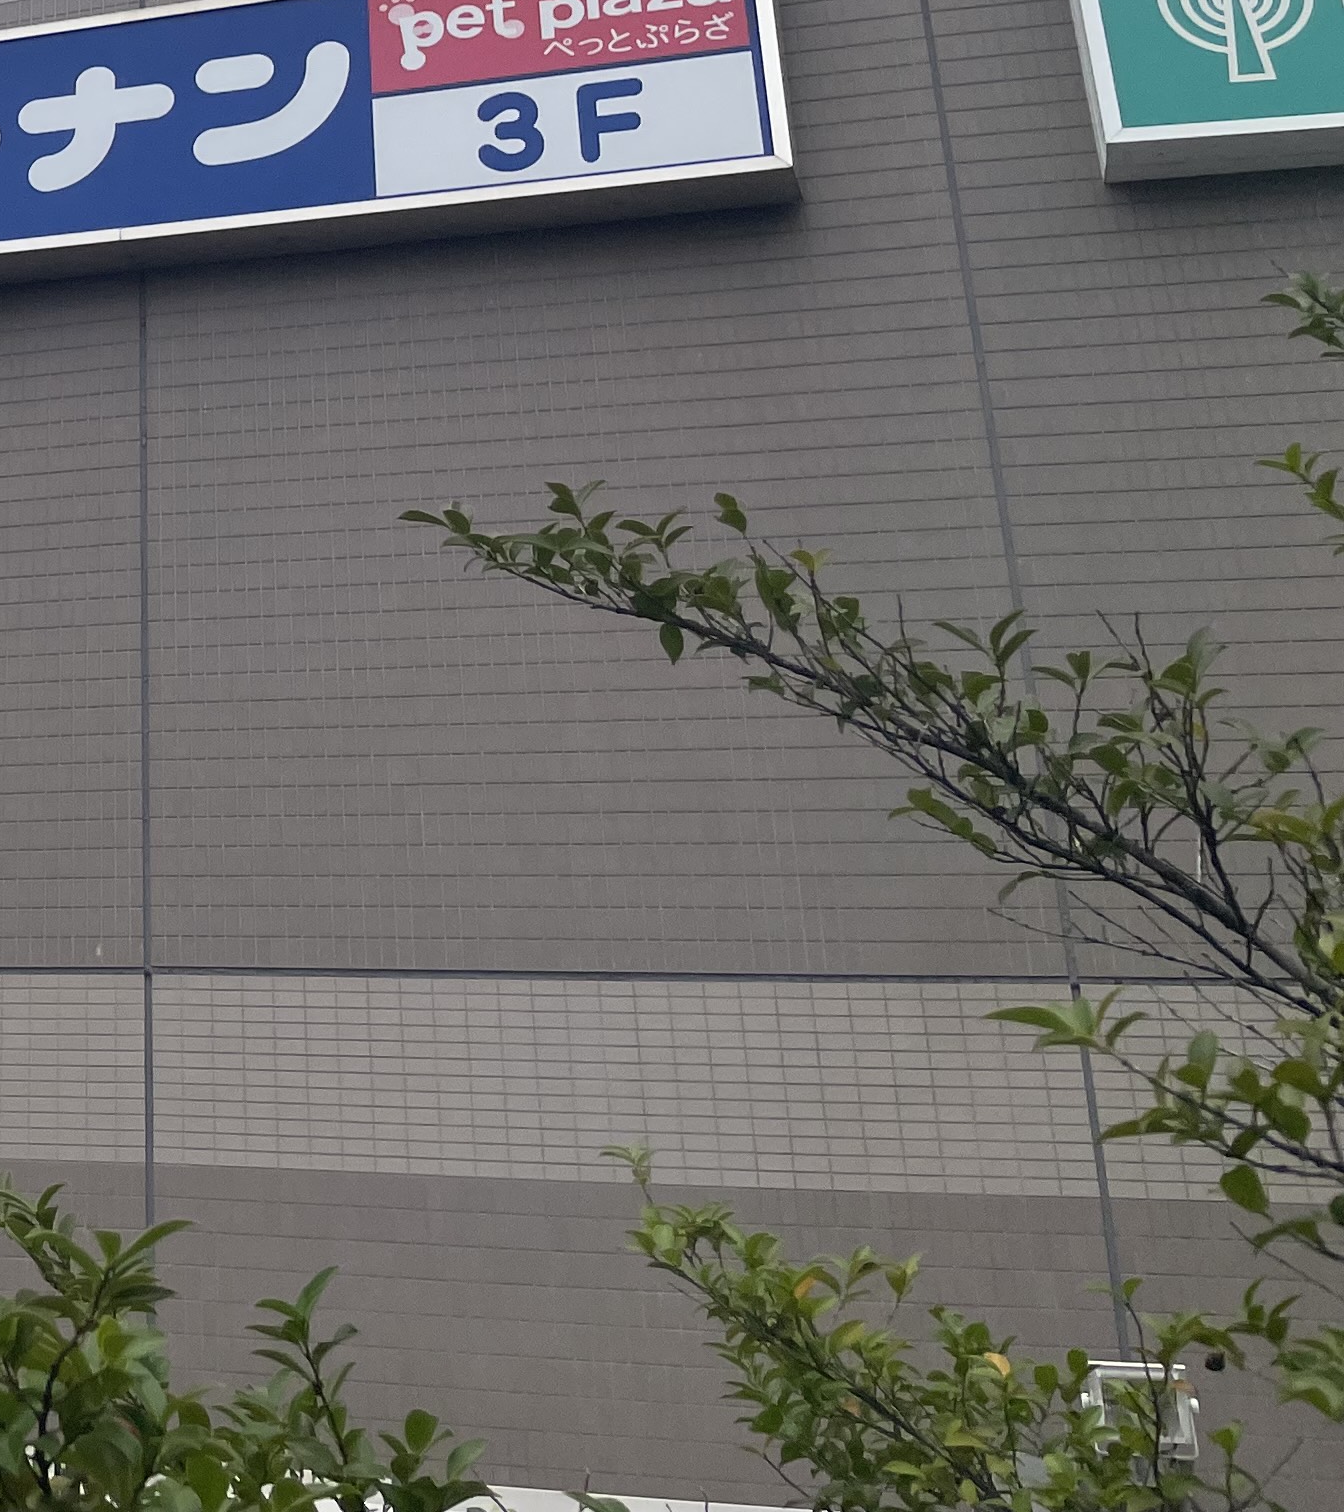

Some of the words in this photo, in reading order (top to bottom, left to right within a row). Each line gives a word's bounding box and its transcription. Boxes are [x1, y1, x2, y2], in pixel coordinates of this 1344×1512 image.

[543, 11, 734, 57] ぺっとぷらざ
[477, 78, 643, 172] 3F
